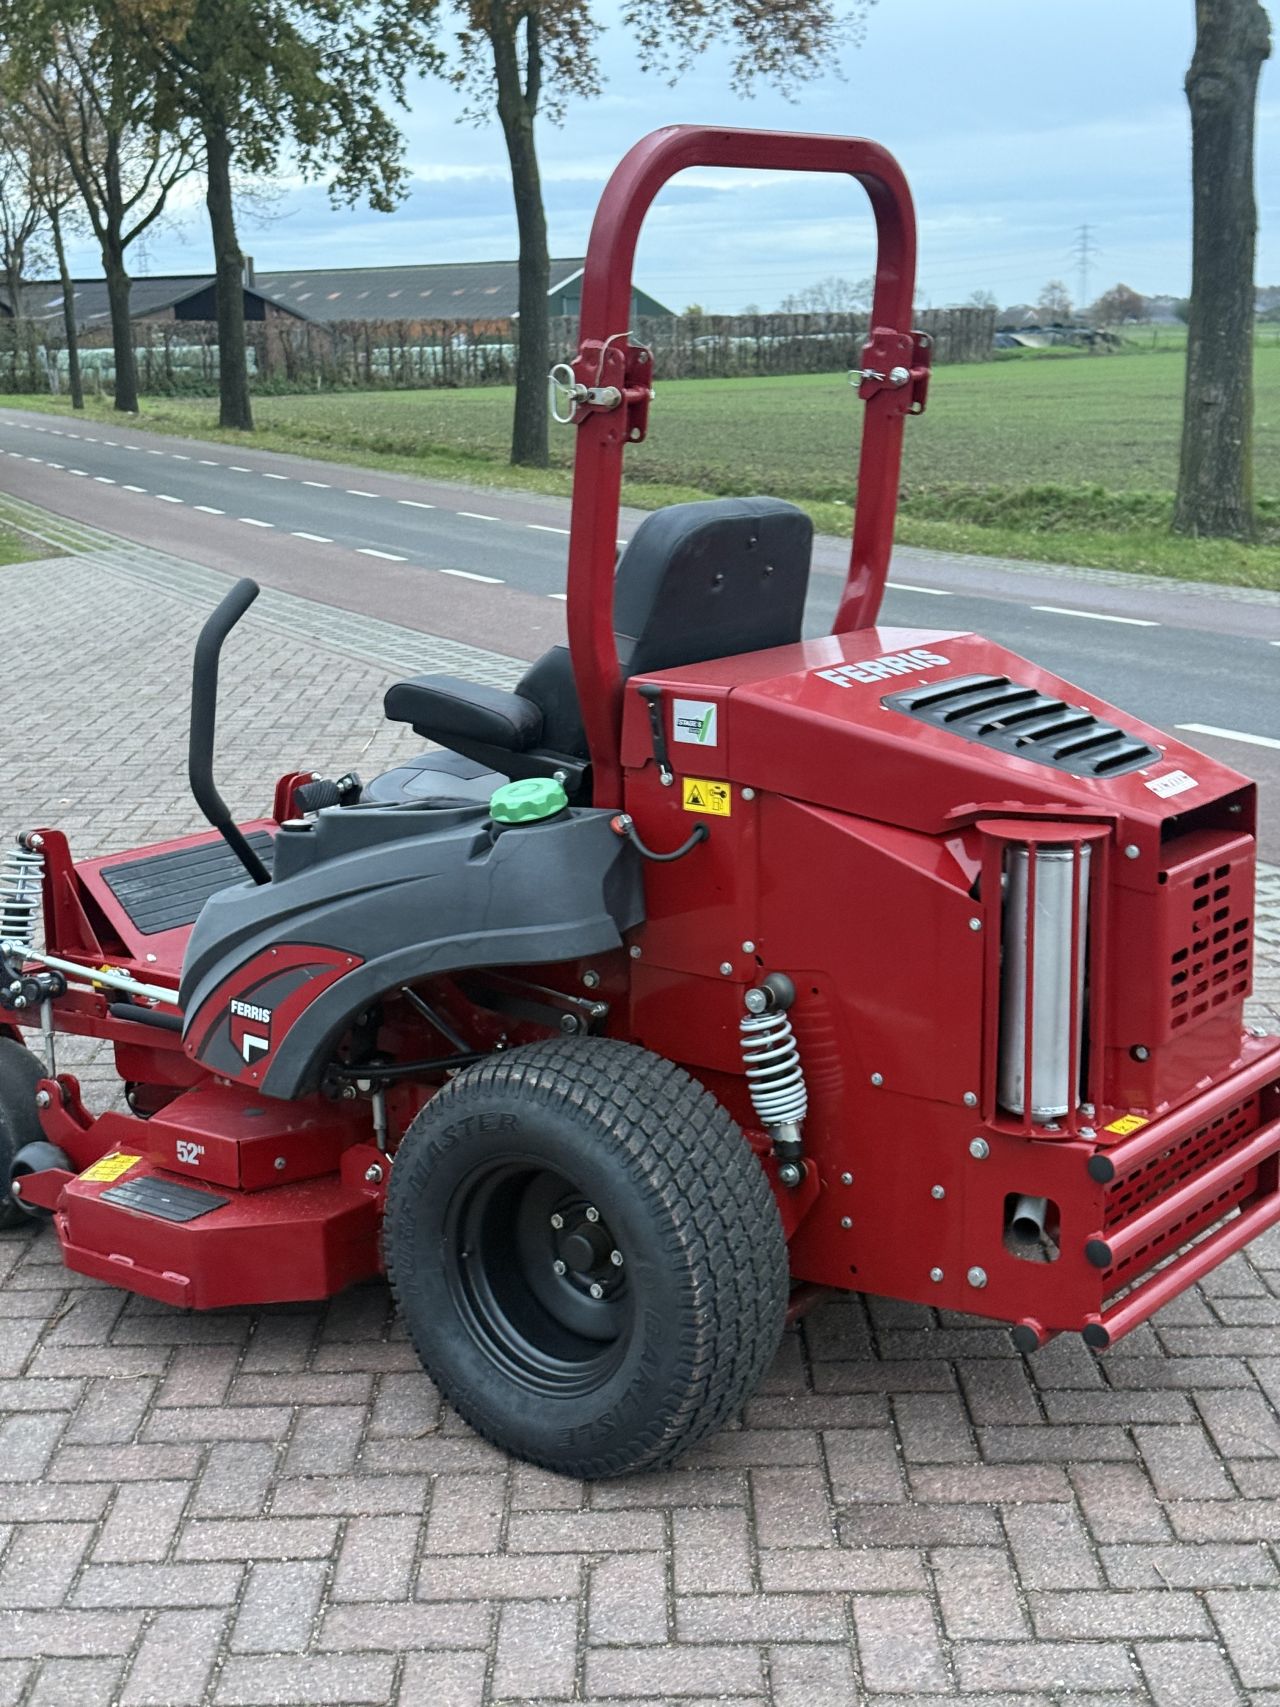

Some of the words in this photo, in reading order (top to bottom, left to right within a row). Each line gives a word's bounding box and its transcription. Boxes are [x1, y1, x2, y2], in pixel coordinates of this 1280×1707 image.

[813, 649, 951, 688] FERRIS
[230, 999, 271, 1023] FERRIS
[176, 1140, 205, 1165] 52"
[408, 1111, 518, 1196] MASTER
